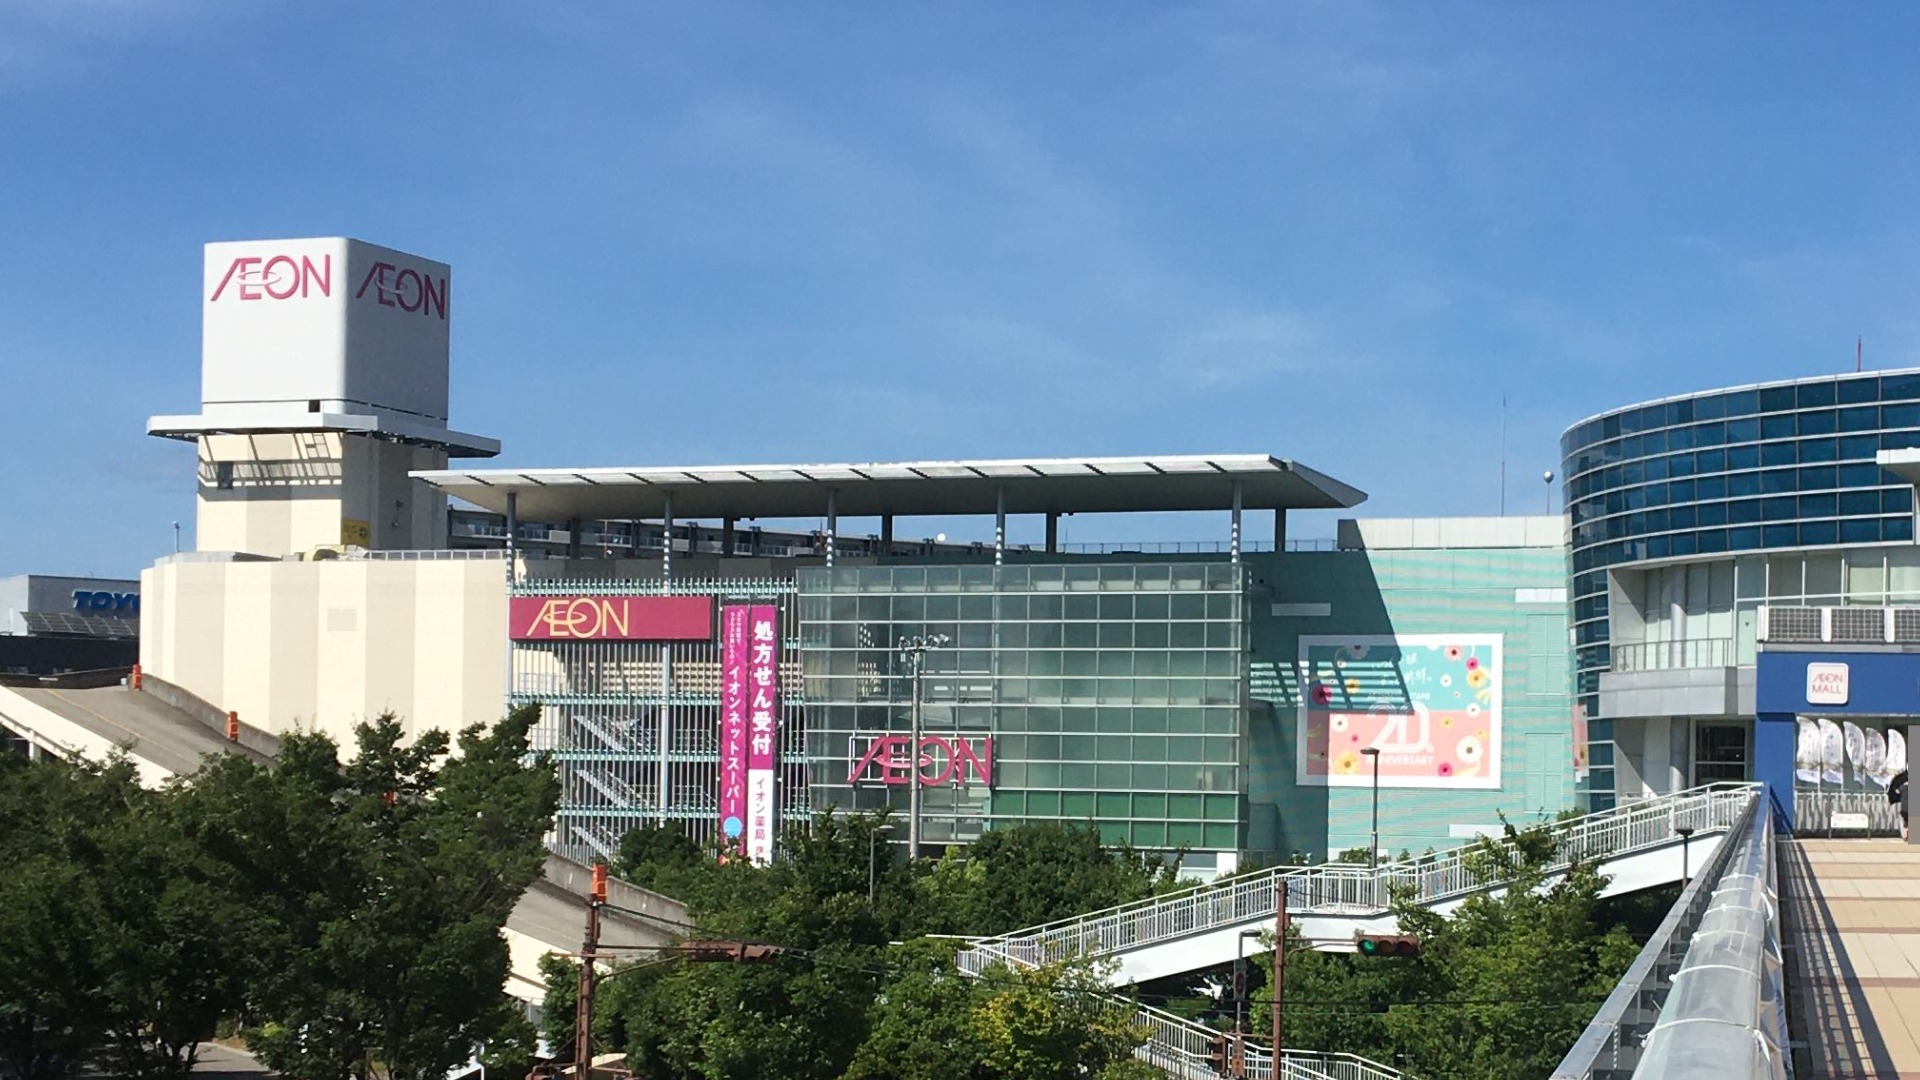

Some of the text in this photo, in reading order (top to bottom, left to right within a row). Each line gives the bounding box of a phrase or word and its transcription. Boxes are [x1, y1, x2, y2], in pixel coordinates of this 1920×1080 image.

[752, 620, 773, 756] 処方せん受付
[1812, 684, 1842, 694] MALL
[727, 665, 741, 813] イオンネットスーパー
[755, 778, 766, 840] イオン薬局
